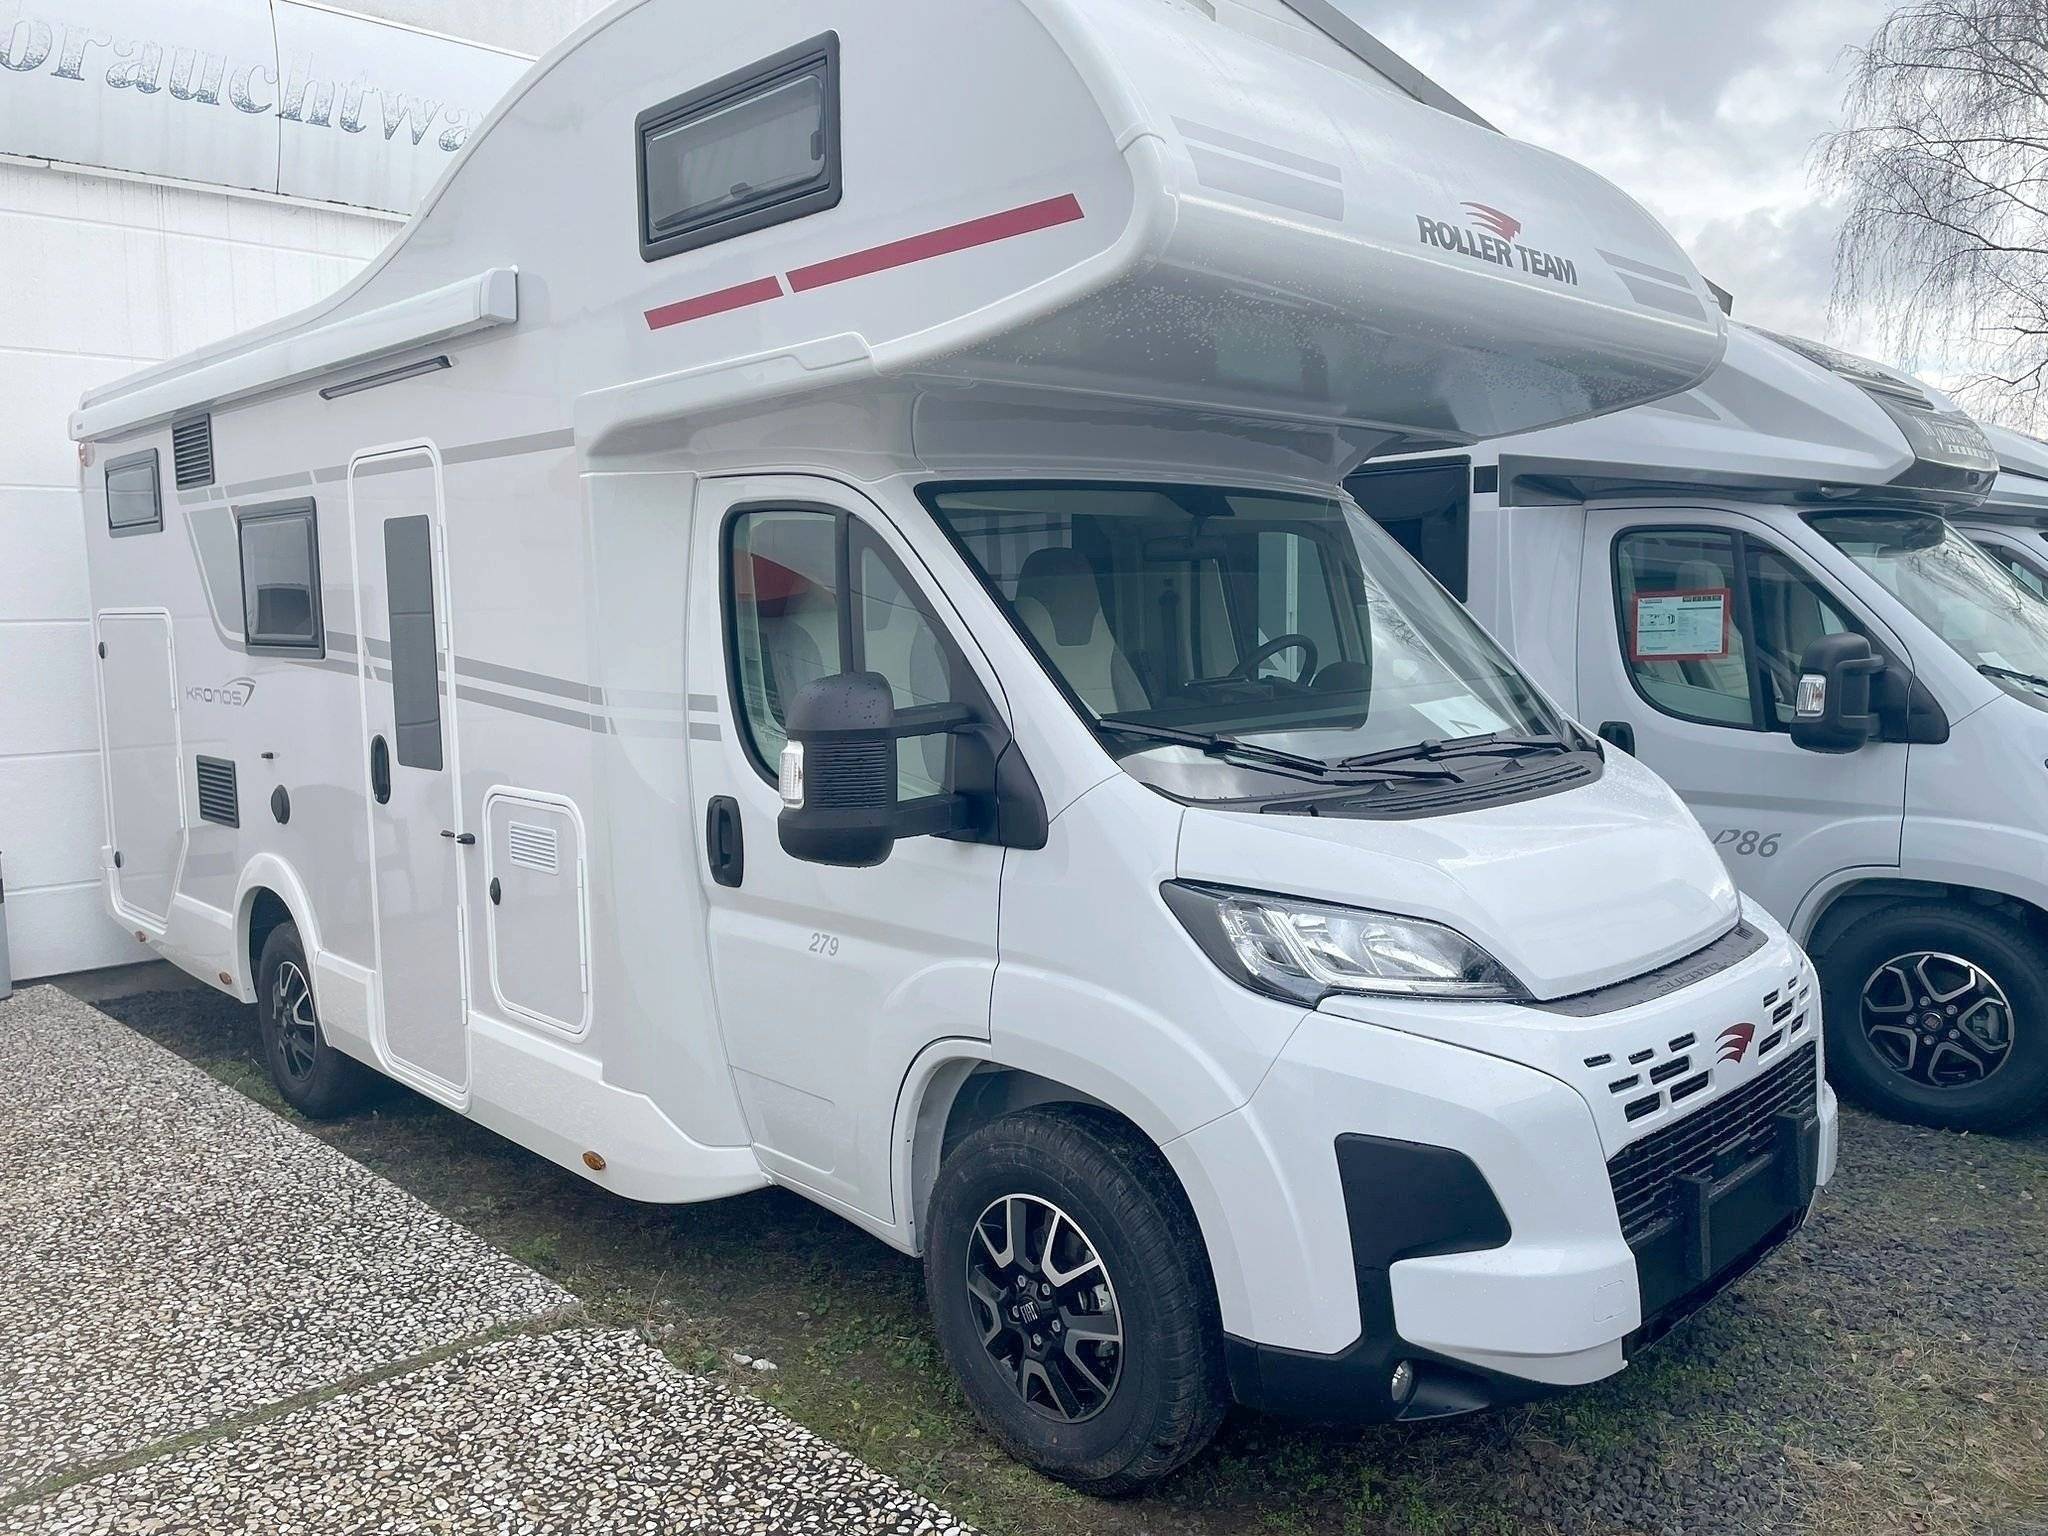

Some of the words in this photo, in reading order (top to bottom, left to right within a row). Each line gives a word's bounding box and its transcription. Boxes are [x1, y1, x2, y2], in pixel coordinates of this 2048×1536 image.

[1415, 214, 1514, 269] ROLLER
[1514, 244, 1578, 286] TEAM
[808, 932, 839, 956] 279
[1019, 1301, 1038, 1325] FIAT
